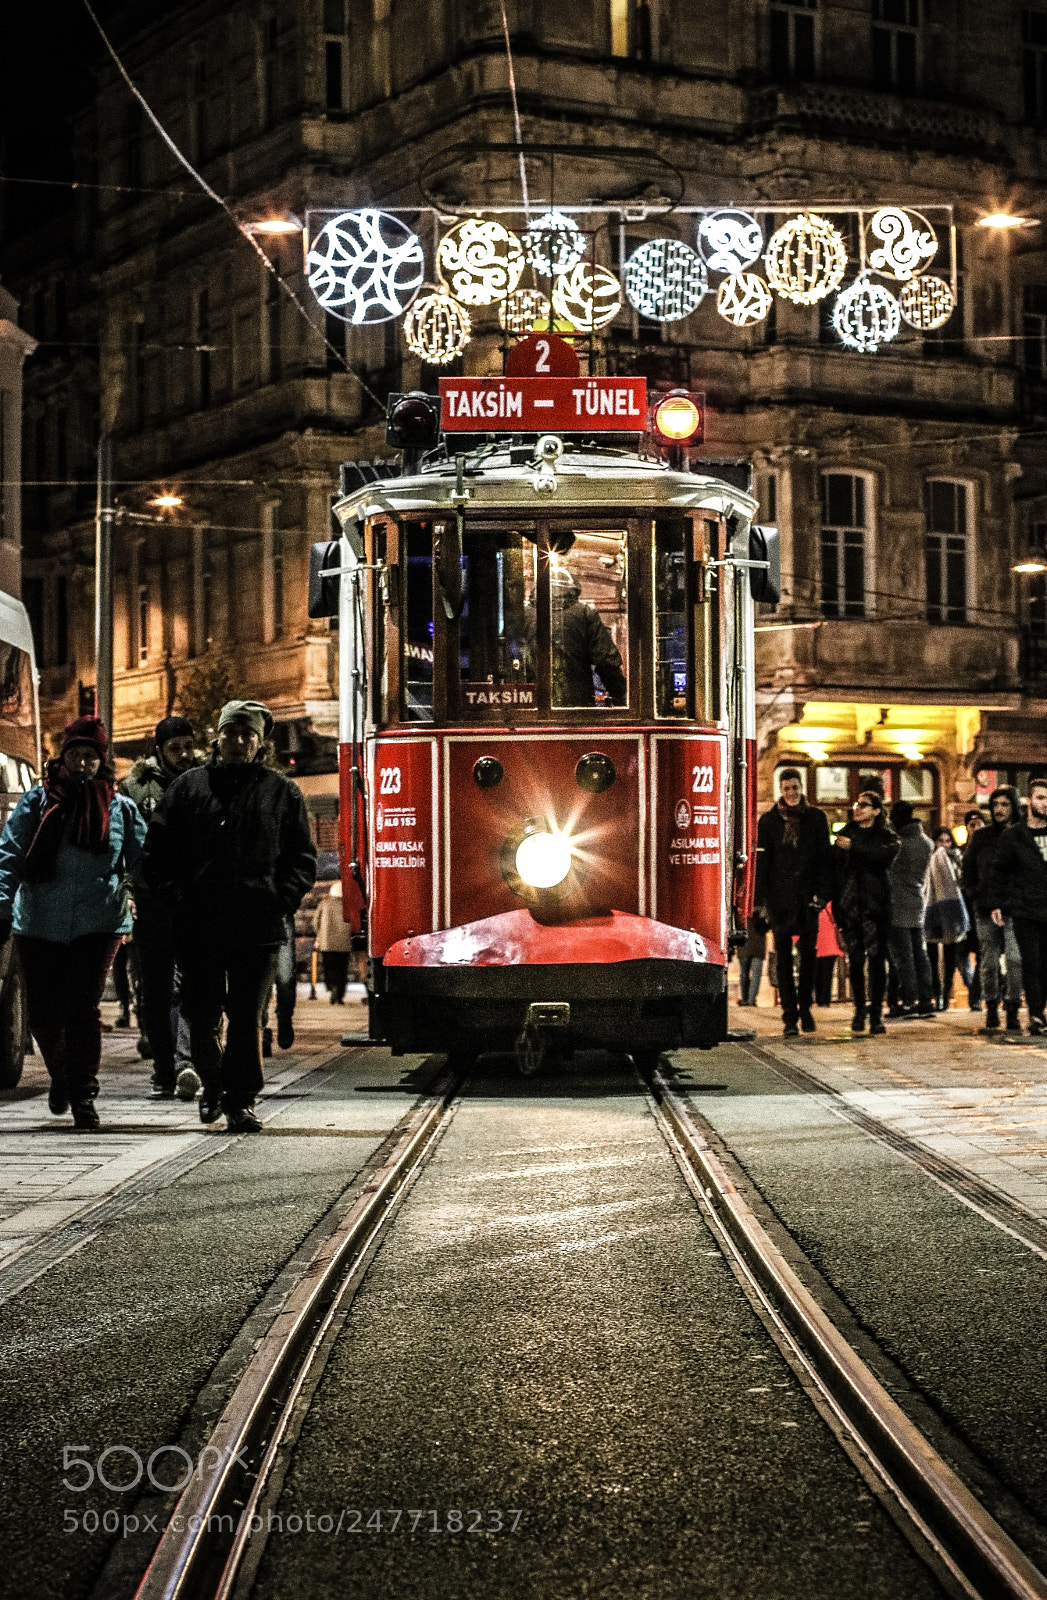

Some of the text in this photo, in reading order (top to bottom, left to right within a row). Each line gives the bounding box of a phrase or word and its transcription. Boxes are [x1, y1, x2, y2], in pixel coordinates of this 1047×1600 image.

[535, 339, 551, 373] 2
[446, 383, 523, 418] TAKSİM
[572, 381, 641, 416] TÜNEL
[466, 688, 533, 704] TAKSİM
[380, 766, 401, 795] 223
[692, 765, 714, 793] 223
[384, 817, 416, 827] ALO 153
[694, 816, 708, 825] ALO
[398, 842, 424, 852] YASAK
[671, 838, 705, 849] ASILMAK
